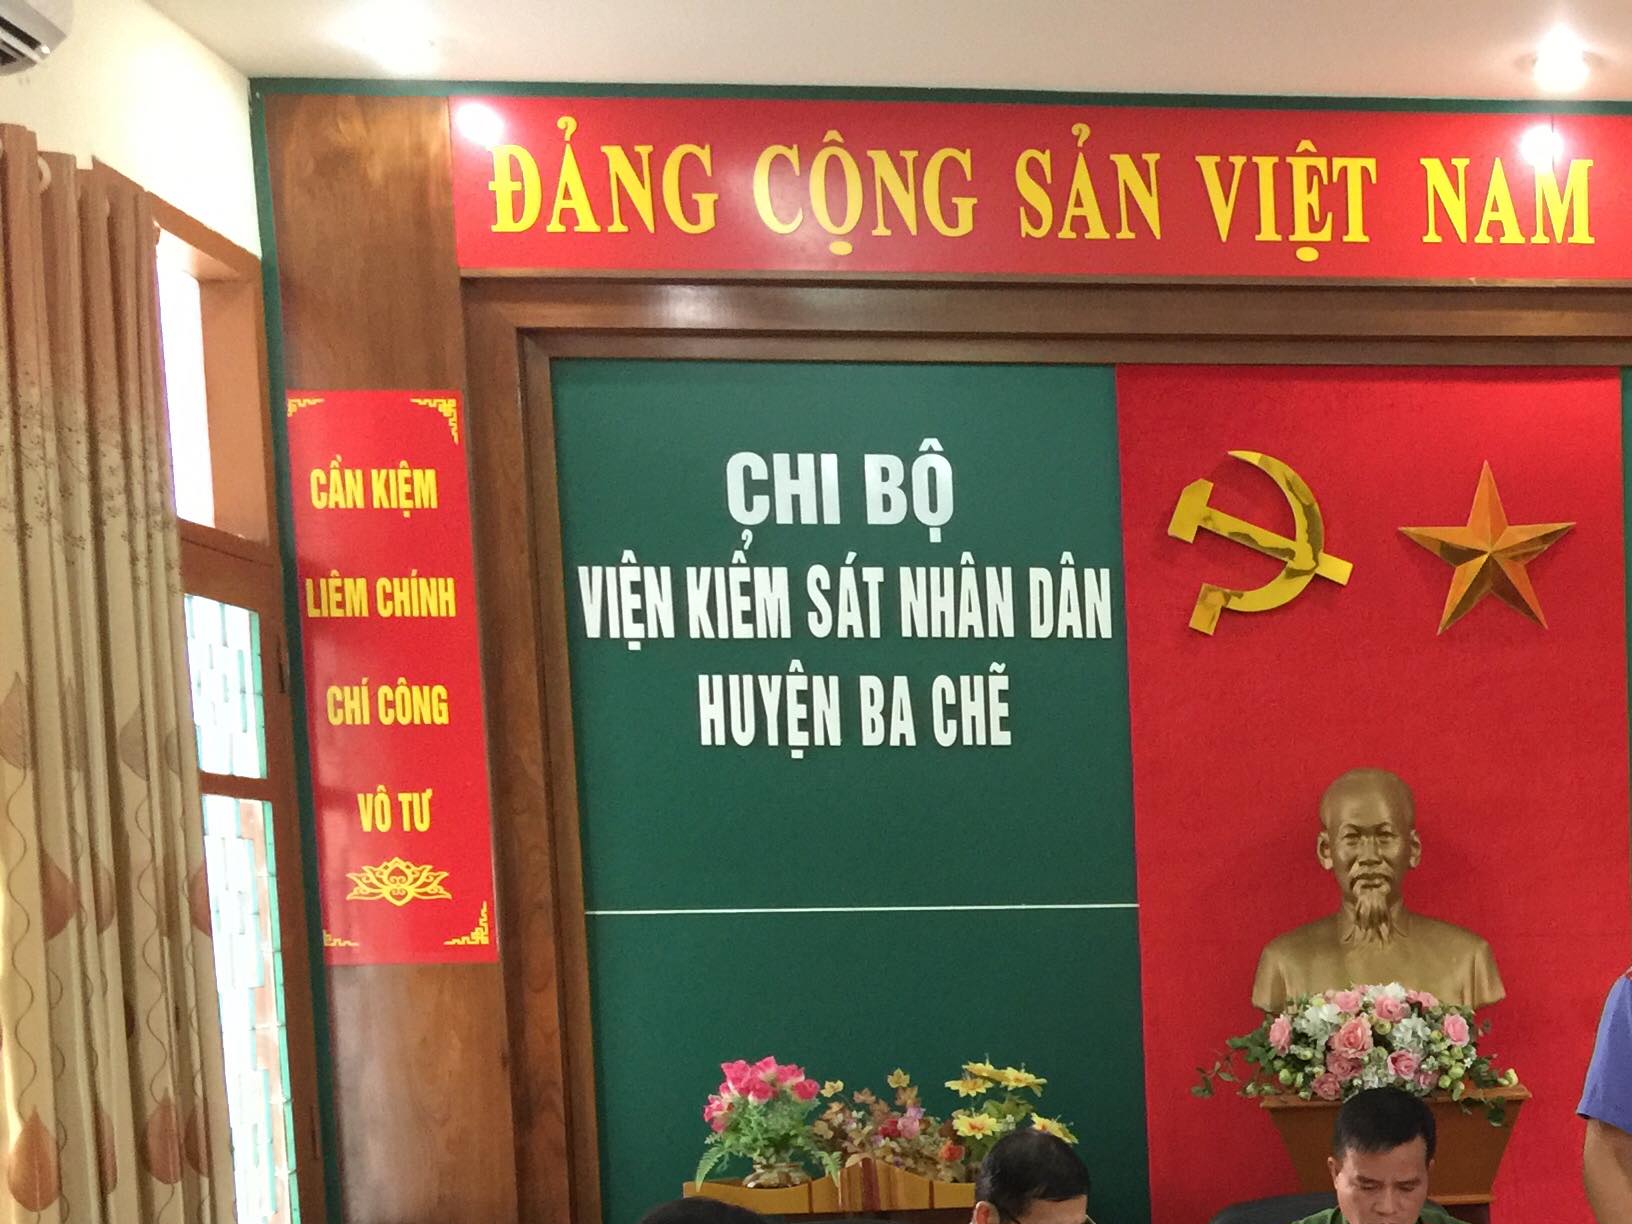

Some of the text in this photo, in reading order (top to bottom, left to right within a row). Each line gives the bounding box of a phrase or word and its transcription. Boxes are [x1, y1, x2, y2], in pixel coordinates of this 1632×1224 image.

[487, 115, 719, 234] ĐẢNG
[753, 129, 975, 256] CỘNG
[1015, 123, 1161, 240] SẢN
[1195, 140, 1376, 262] VIỆT
[1420, 156, 1596, 245] NAM
[310, 455, 437, 517] CẦN KIỆM
[727, 438, 953, 542] CHI BỘ
[306, 570, 456, 617] LIÊM CHÍNH
[578, 529, 1111, 650] VIỆN KIỂM SÁT NHÂN DÂN
[326, 677, 449, 726] CHÍ CÔNG
[699, 660, 1011, 758] HUYỆN BA CHẼ
[357, 784, 432, 832] VÔ TƯ
